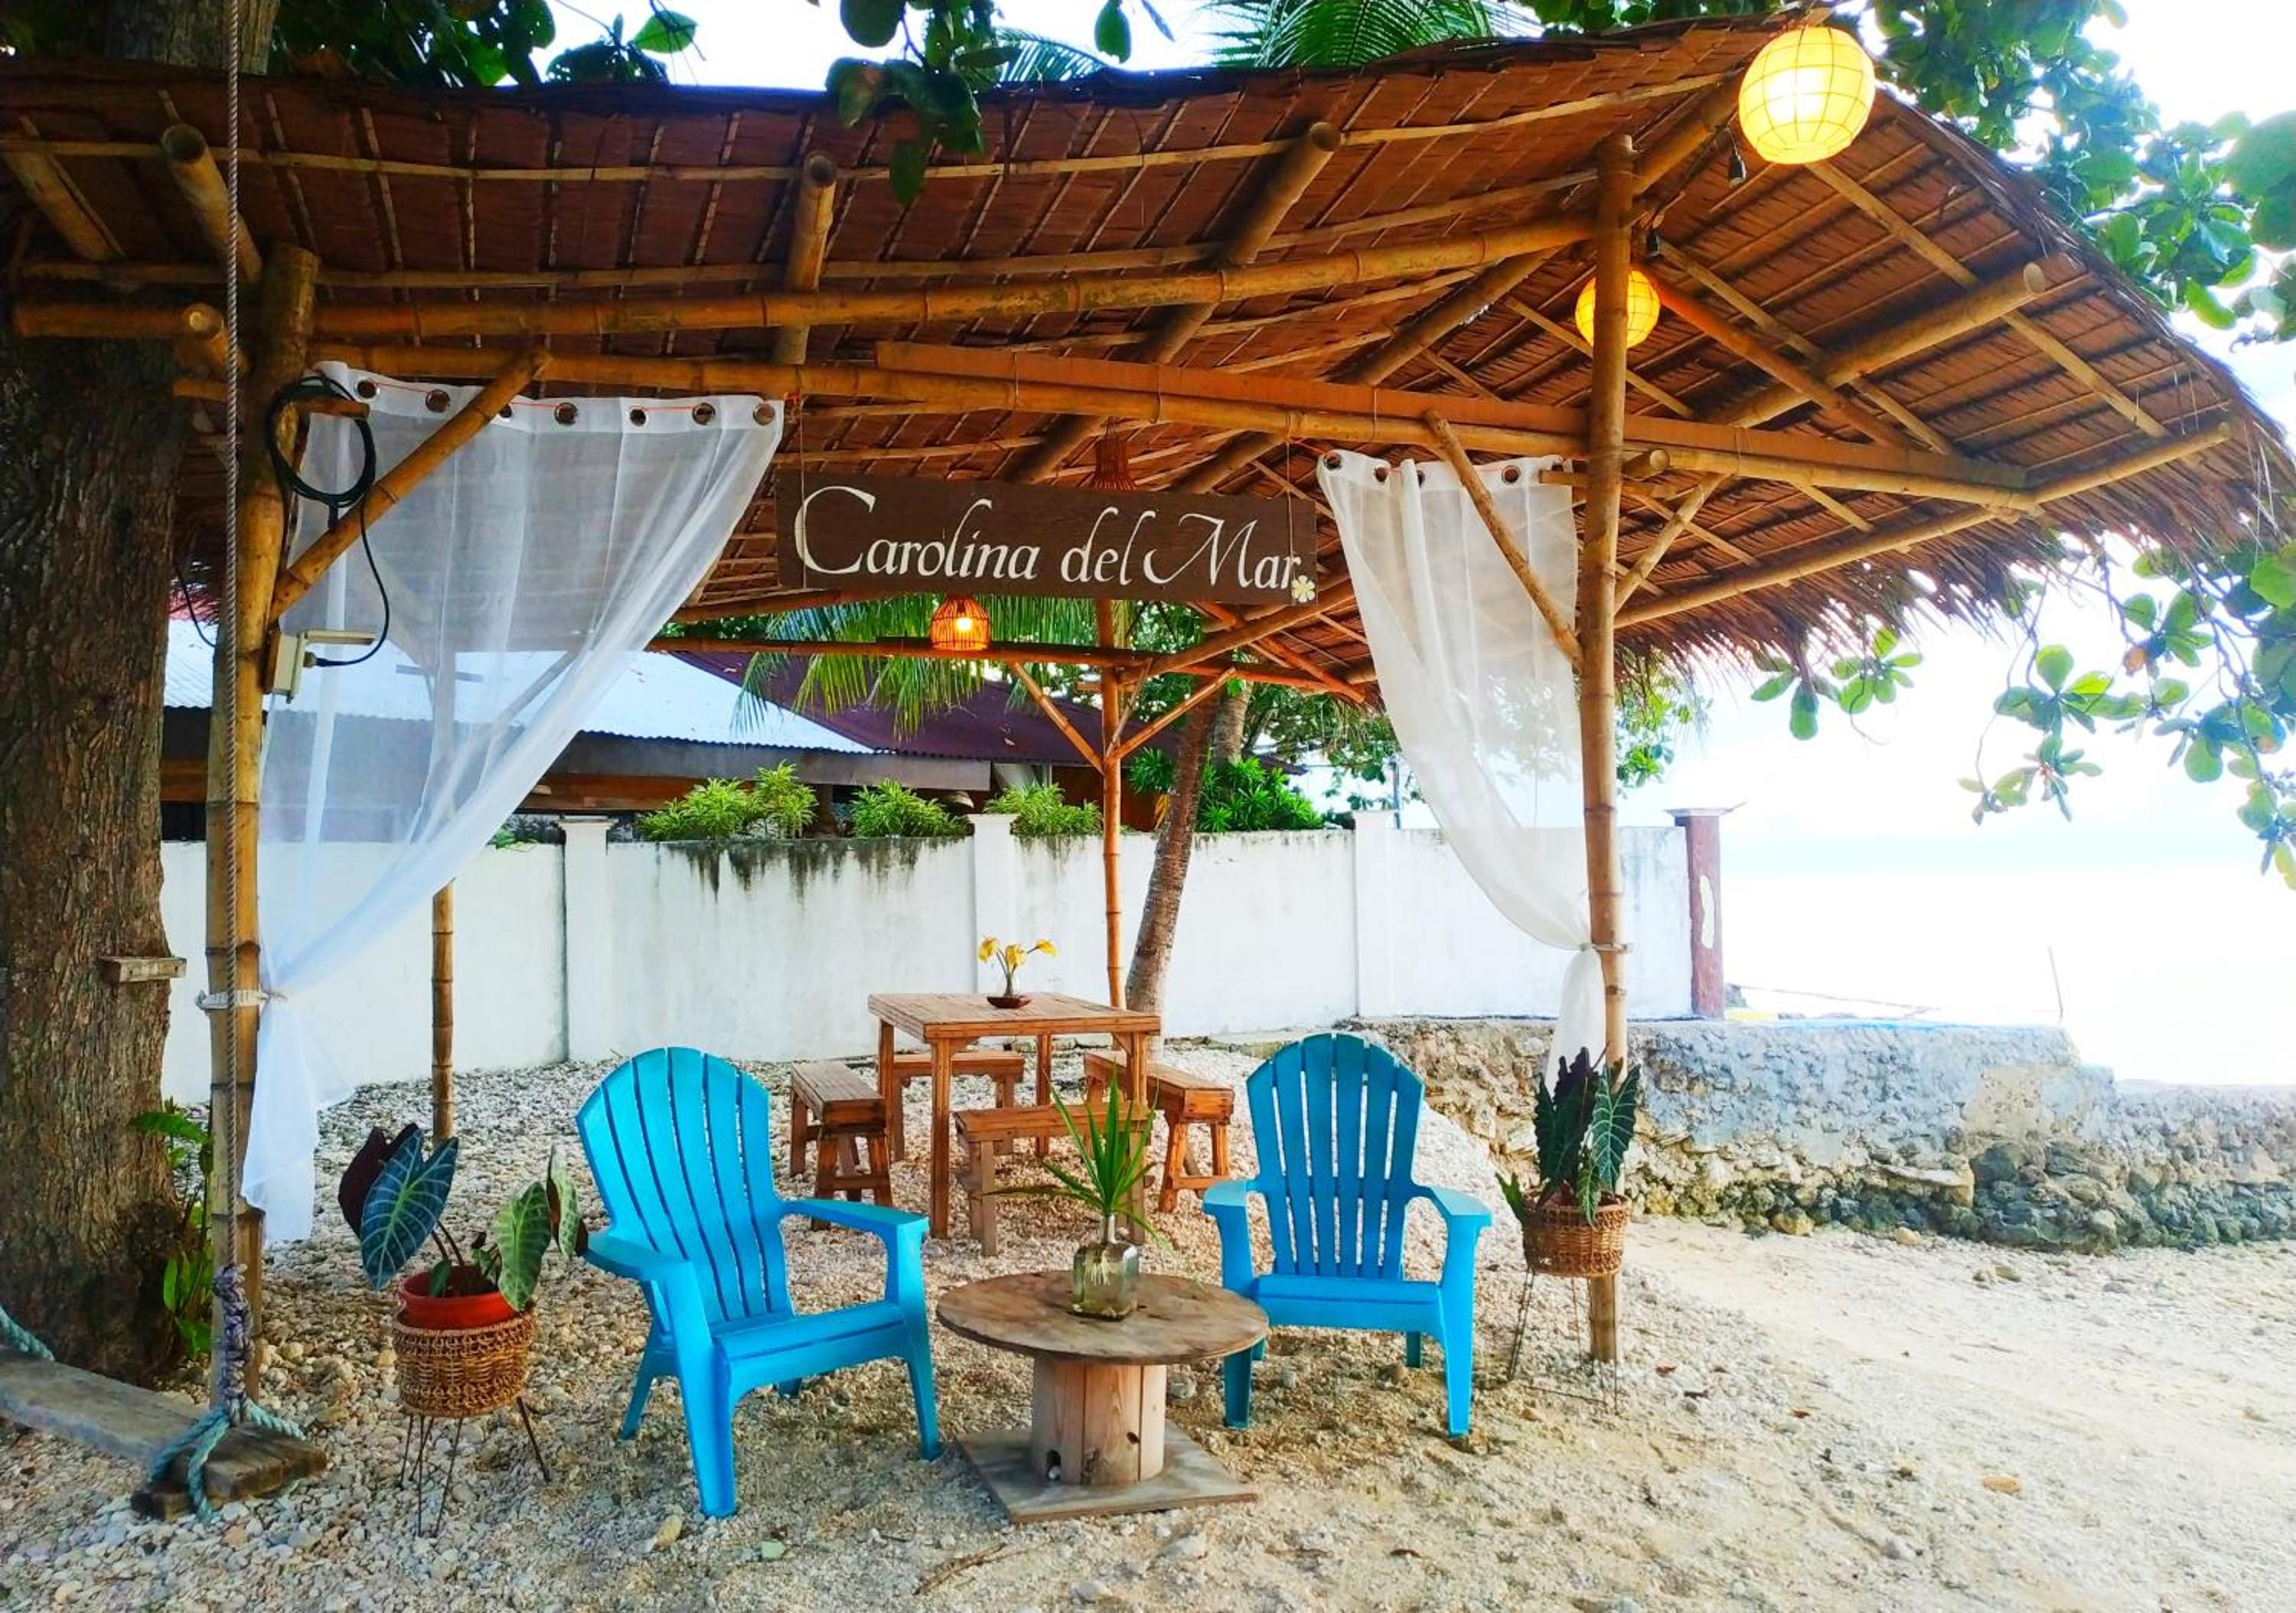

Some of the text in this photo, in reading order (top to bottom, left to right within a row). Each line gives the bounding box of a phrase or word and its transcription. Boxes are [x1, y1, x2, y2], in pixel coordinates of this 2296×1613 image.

[794, 485, 1302, 589] Carolina del Mar
